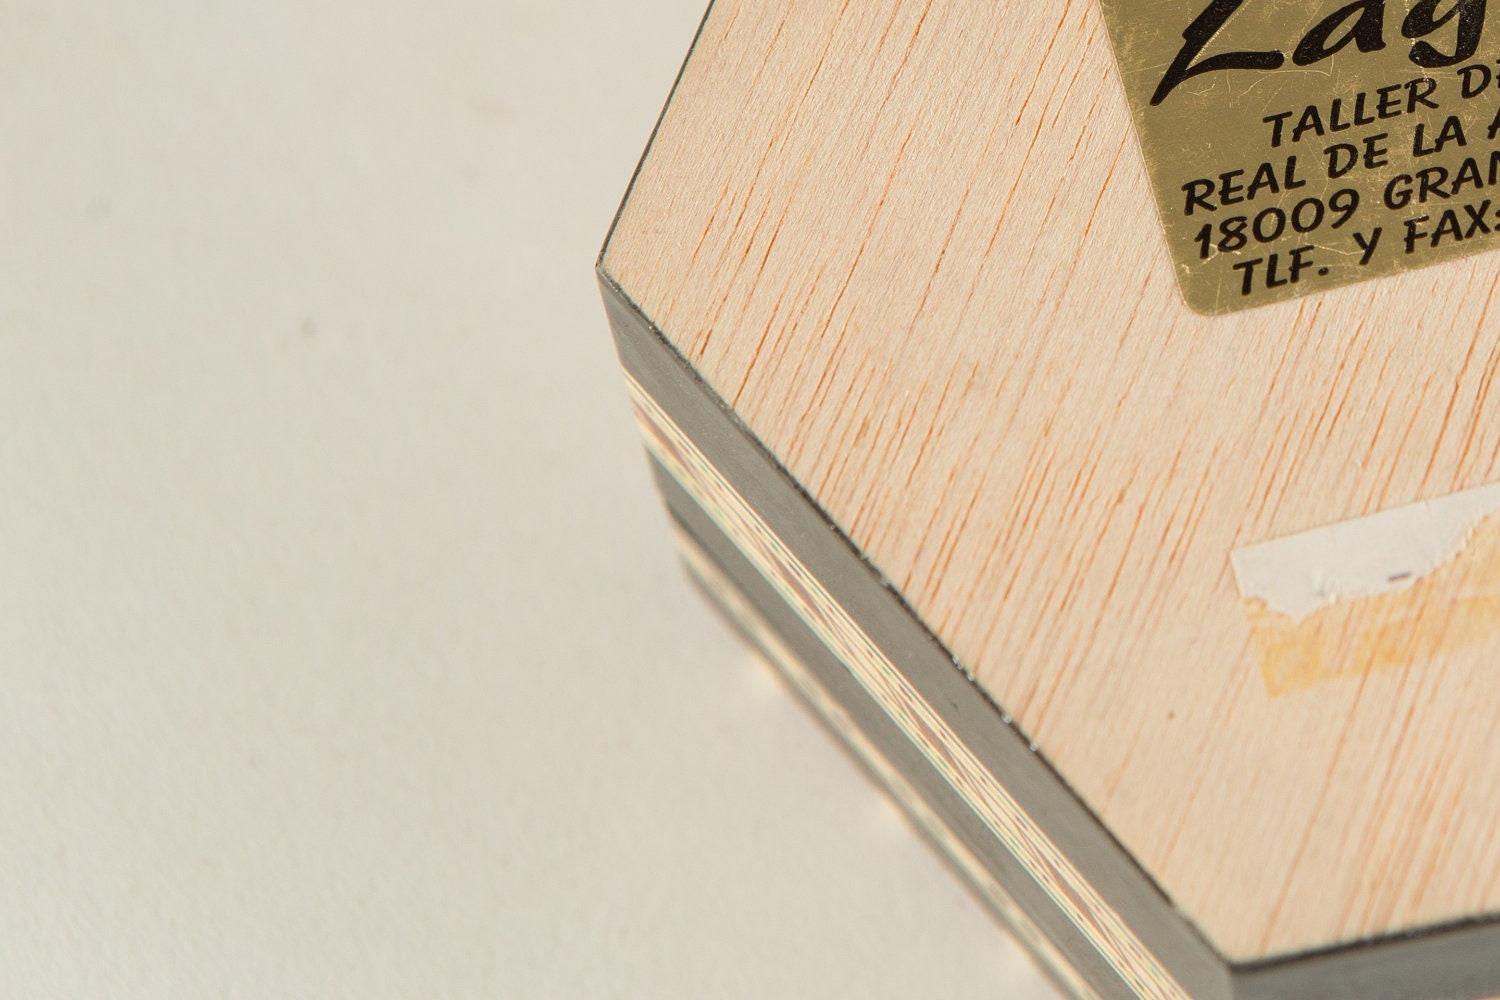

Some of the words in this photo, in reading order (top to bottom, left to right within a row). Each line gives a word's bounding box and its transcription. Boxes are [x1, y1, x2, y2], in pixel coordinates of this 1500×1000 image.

[1262, 77, 1440, 148] TALLER
[1181, 155, 1307, 217] REAL
[1323, 132, 1389, 180] DE
[1412, 115, 1468, 158] LA
[1193, 188, 1360, 260] 18009
[1232, 245, 1329, 296] TLF.
